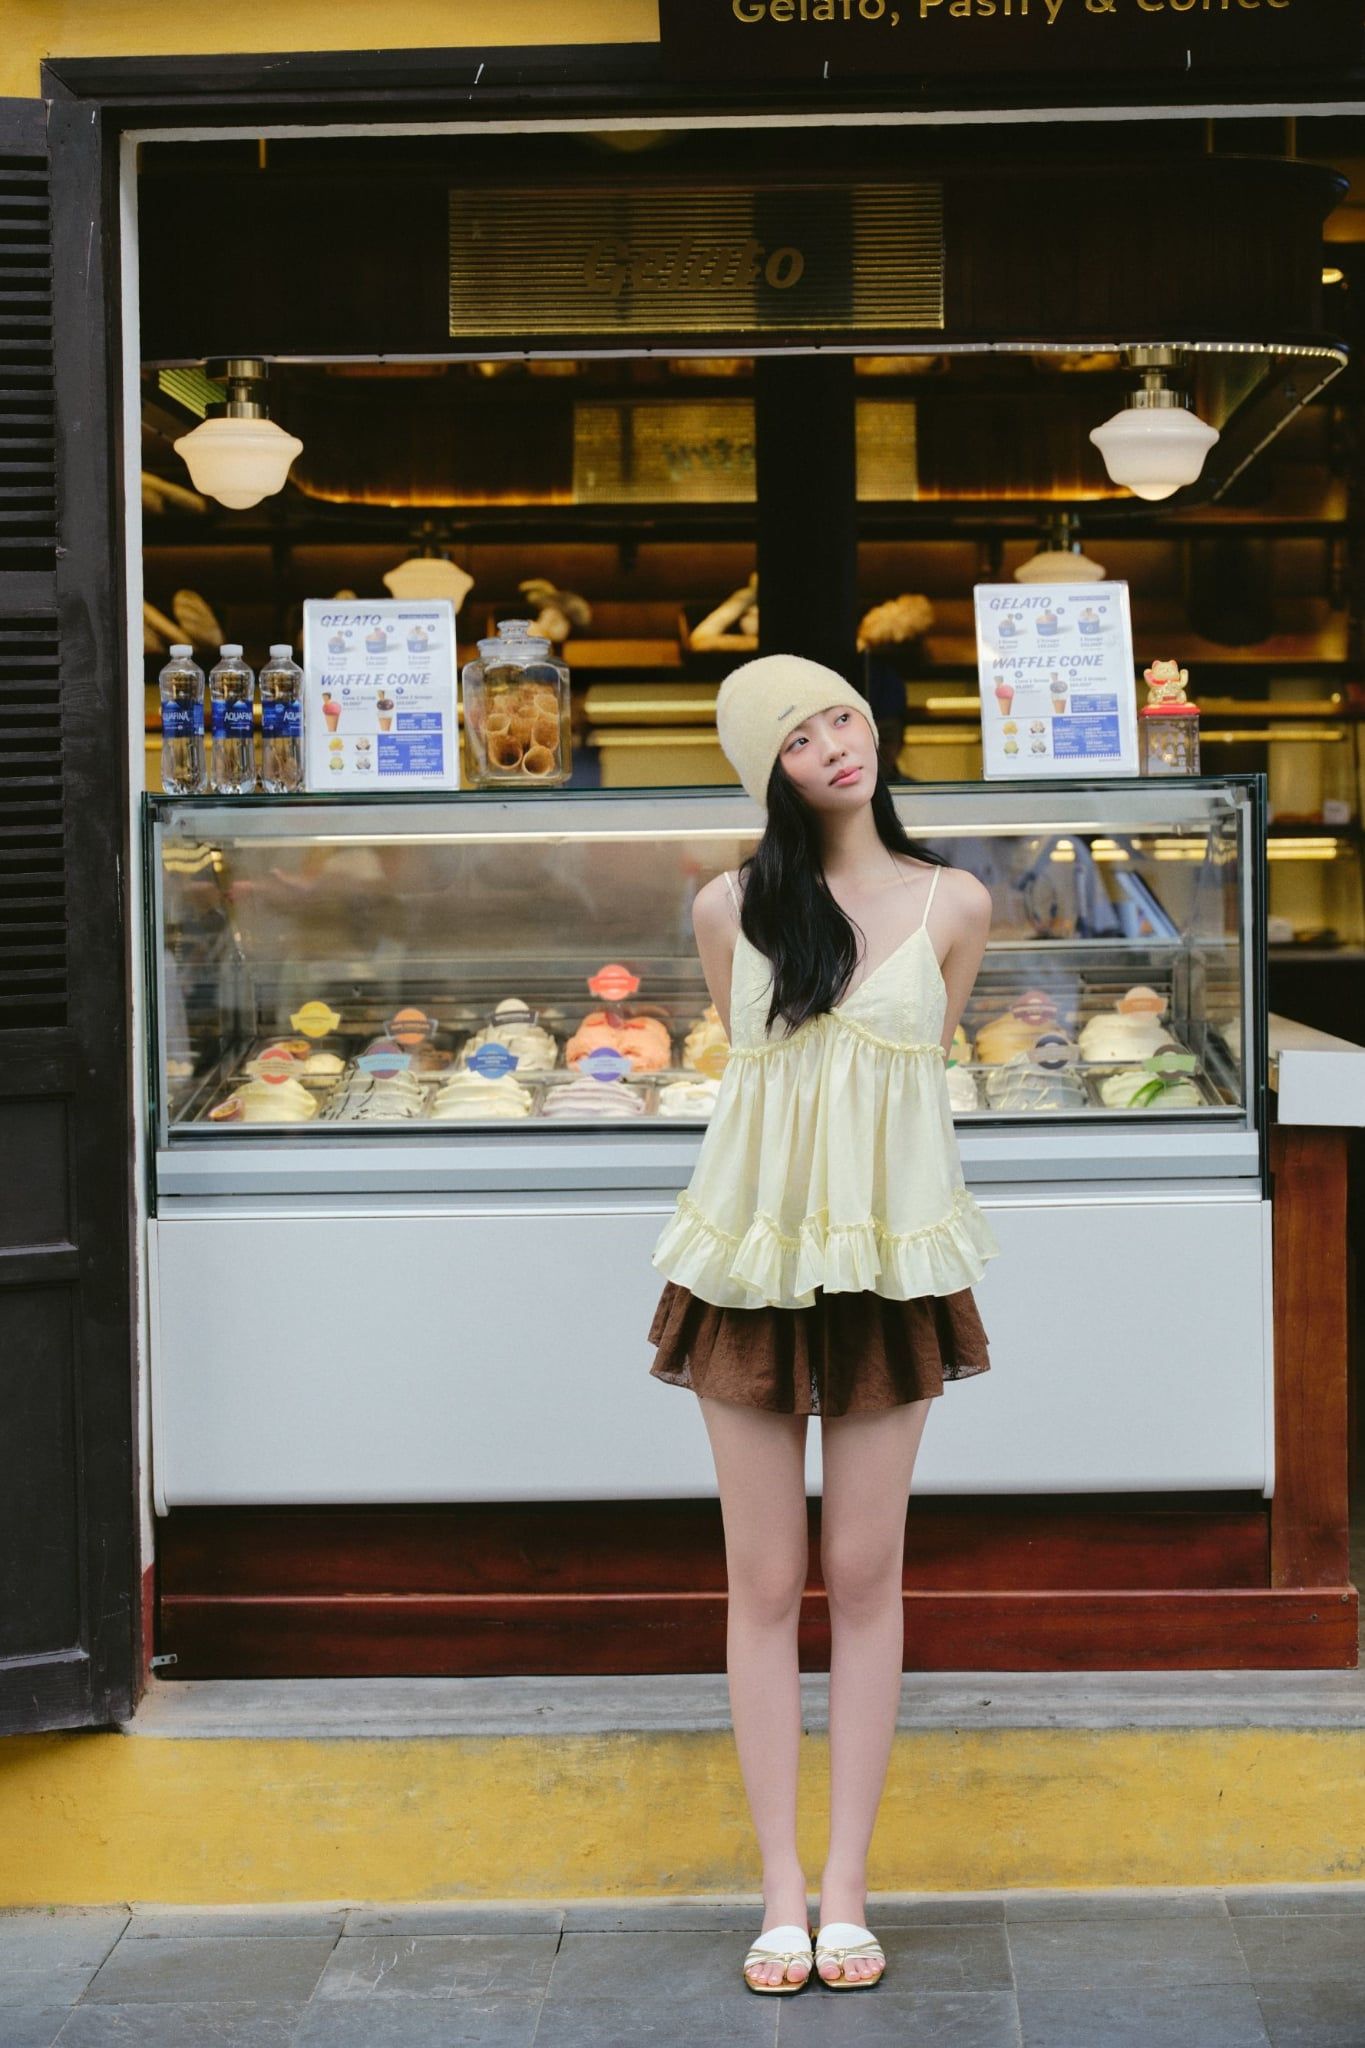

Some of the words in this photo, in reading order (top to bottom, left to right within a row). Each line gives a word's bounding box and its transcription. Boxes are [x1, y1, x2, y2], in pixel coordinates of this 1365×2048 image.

[583, 236, 805, 297] Gelato
[989, 597, 1051, 610] GELATO
[320, 614, 381, 627] GELATO
[992, 655, 1056, 669] WAFFLE
[1059, 654, 1104, 667] CONE
[320, 673, 384, 686] WAFFLE
[387, 672, 431, 685] CONE
